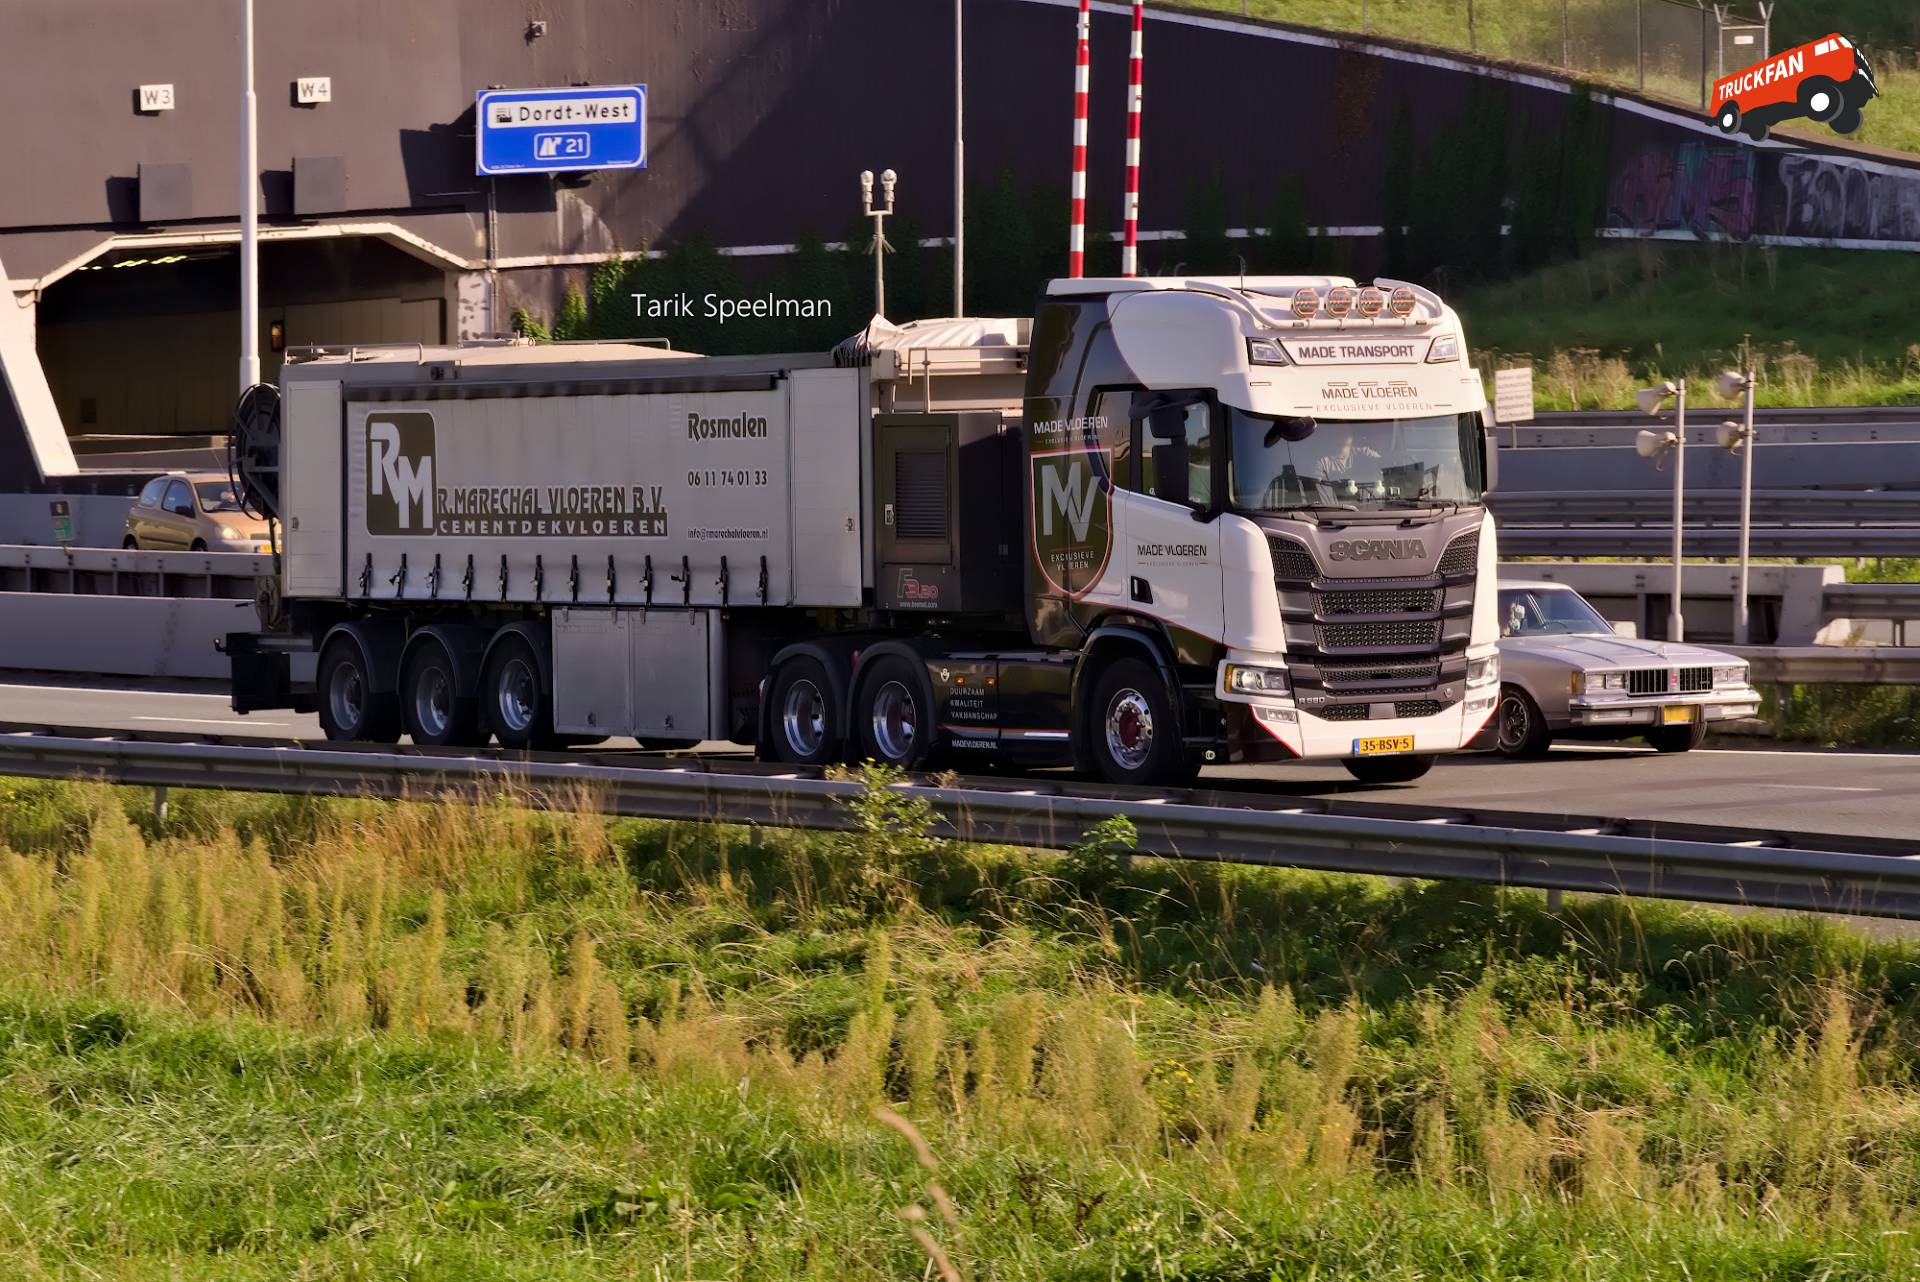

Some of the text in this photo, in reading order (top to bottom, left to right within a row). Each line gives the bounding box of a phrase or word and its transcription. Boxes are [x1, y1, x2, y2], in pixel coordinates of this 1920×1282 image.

[519, 103, 629, 122] Dordt-West
[565, 138, 583, 153] 21
[1298, 345, 1415, 358] MADE TRANSPORT
[1321, 386, 1418, 399] MADE VLOEREN
[687, 411, 767, 442] Rosmalen
[1034, 416, 1109, 435] MADE VLOEREN
[687, 470, 768, 486] 06 11 74 01 33
[547, 486, 626, 514] VLOEREN
[632, 486, 666, 514] B.V.
[439, 519, 665, 534] CEMENTDEKVLOEREN
[1137, 544, 1207, 556] MADE VLOEREN
[1328, 539, 1428, 561] SCANIA
[1362, 737, 1410, 751] 35-BSV-5
